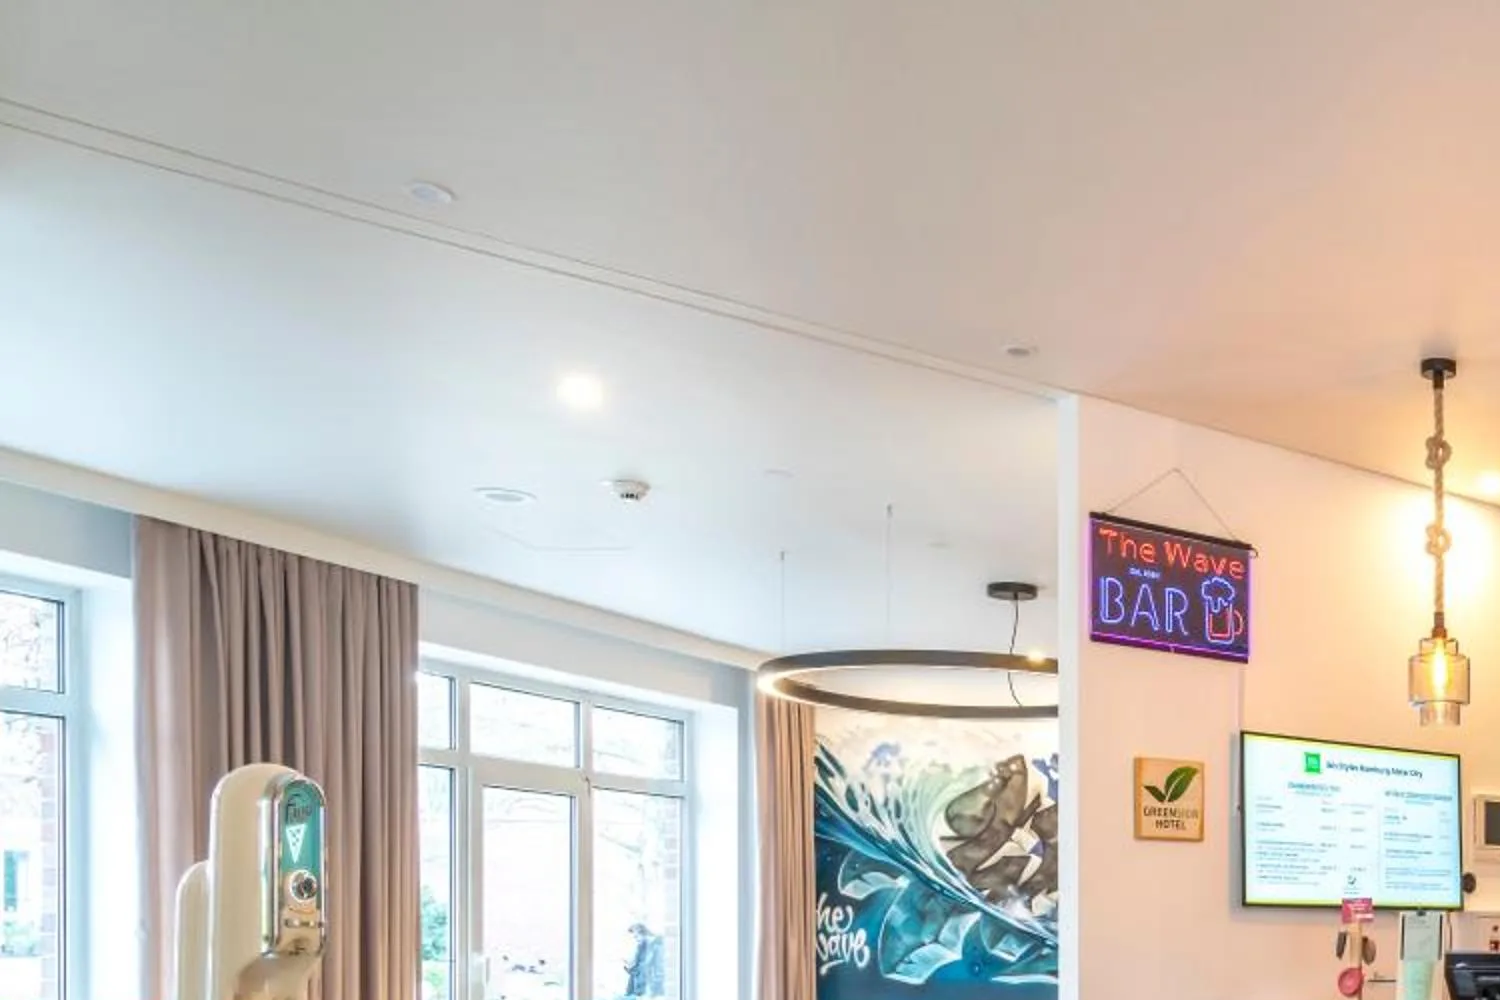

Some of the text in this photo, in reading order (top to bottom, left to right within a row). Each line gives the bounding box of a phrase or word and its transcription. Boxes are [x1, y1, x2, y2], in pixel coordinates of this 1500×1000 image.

[1099, 527, 1246, 580] The Wave
[1100, 576, 1189, 636] BAR
[1155, 819, 1187, 831] HOTEL
[816, 892, 854, 934] he
